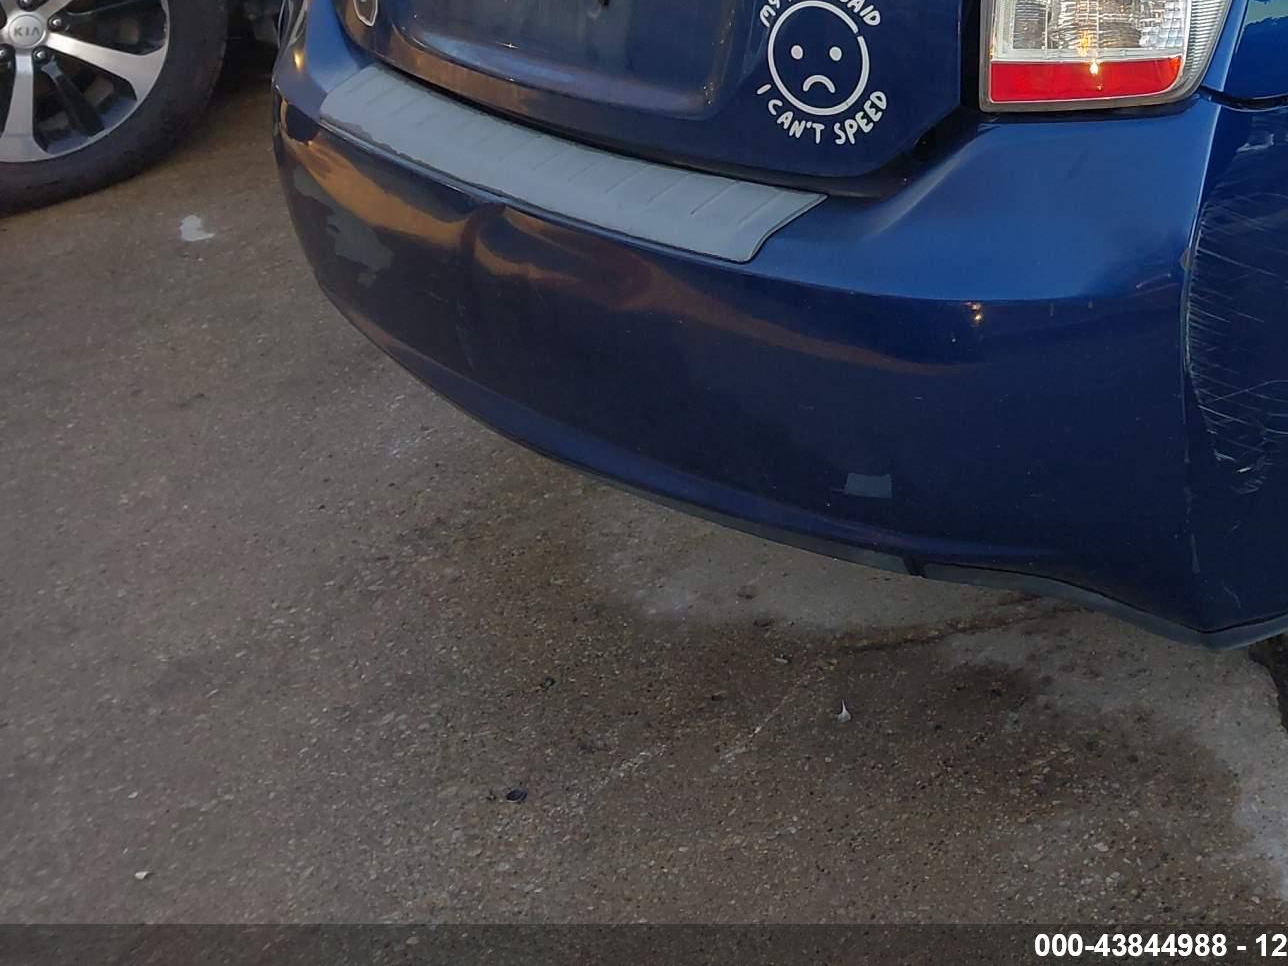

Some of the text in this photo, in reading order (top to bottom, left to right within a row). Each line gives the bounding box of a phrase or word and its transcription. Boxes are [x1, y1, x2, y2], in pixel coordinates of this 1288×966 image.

[14, 26, 40, 36] KIA
[757, 84, 887, 145] I CAN'T SPEED
